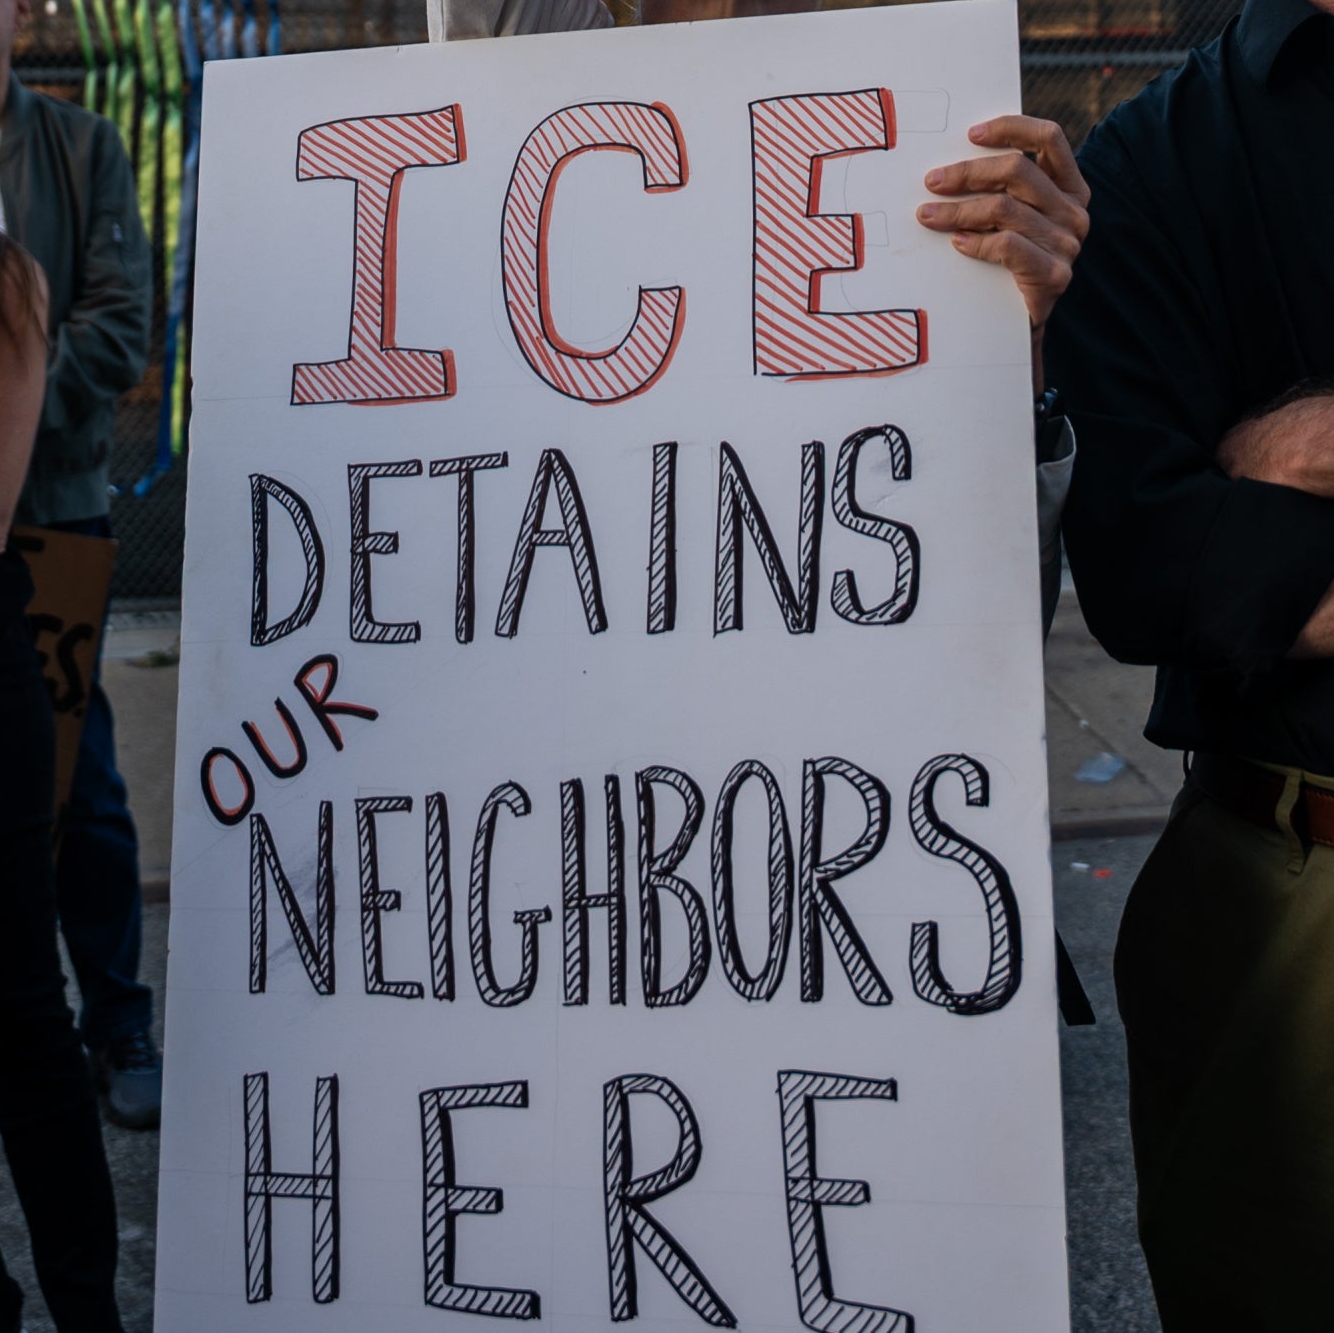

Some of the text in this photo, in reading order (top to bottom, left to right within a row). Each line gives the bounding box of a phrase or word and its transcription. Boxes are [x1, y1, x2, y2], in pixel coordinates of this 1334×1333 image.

[291, 87, 927, 406] ICE
[250, 424, 920, 645] DETAINS
[201, 654, 379, 826] OUR
[249, 754, 1022, 1014] NEIGHBORS
[244, 1070, 915, 1333] HERE
